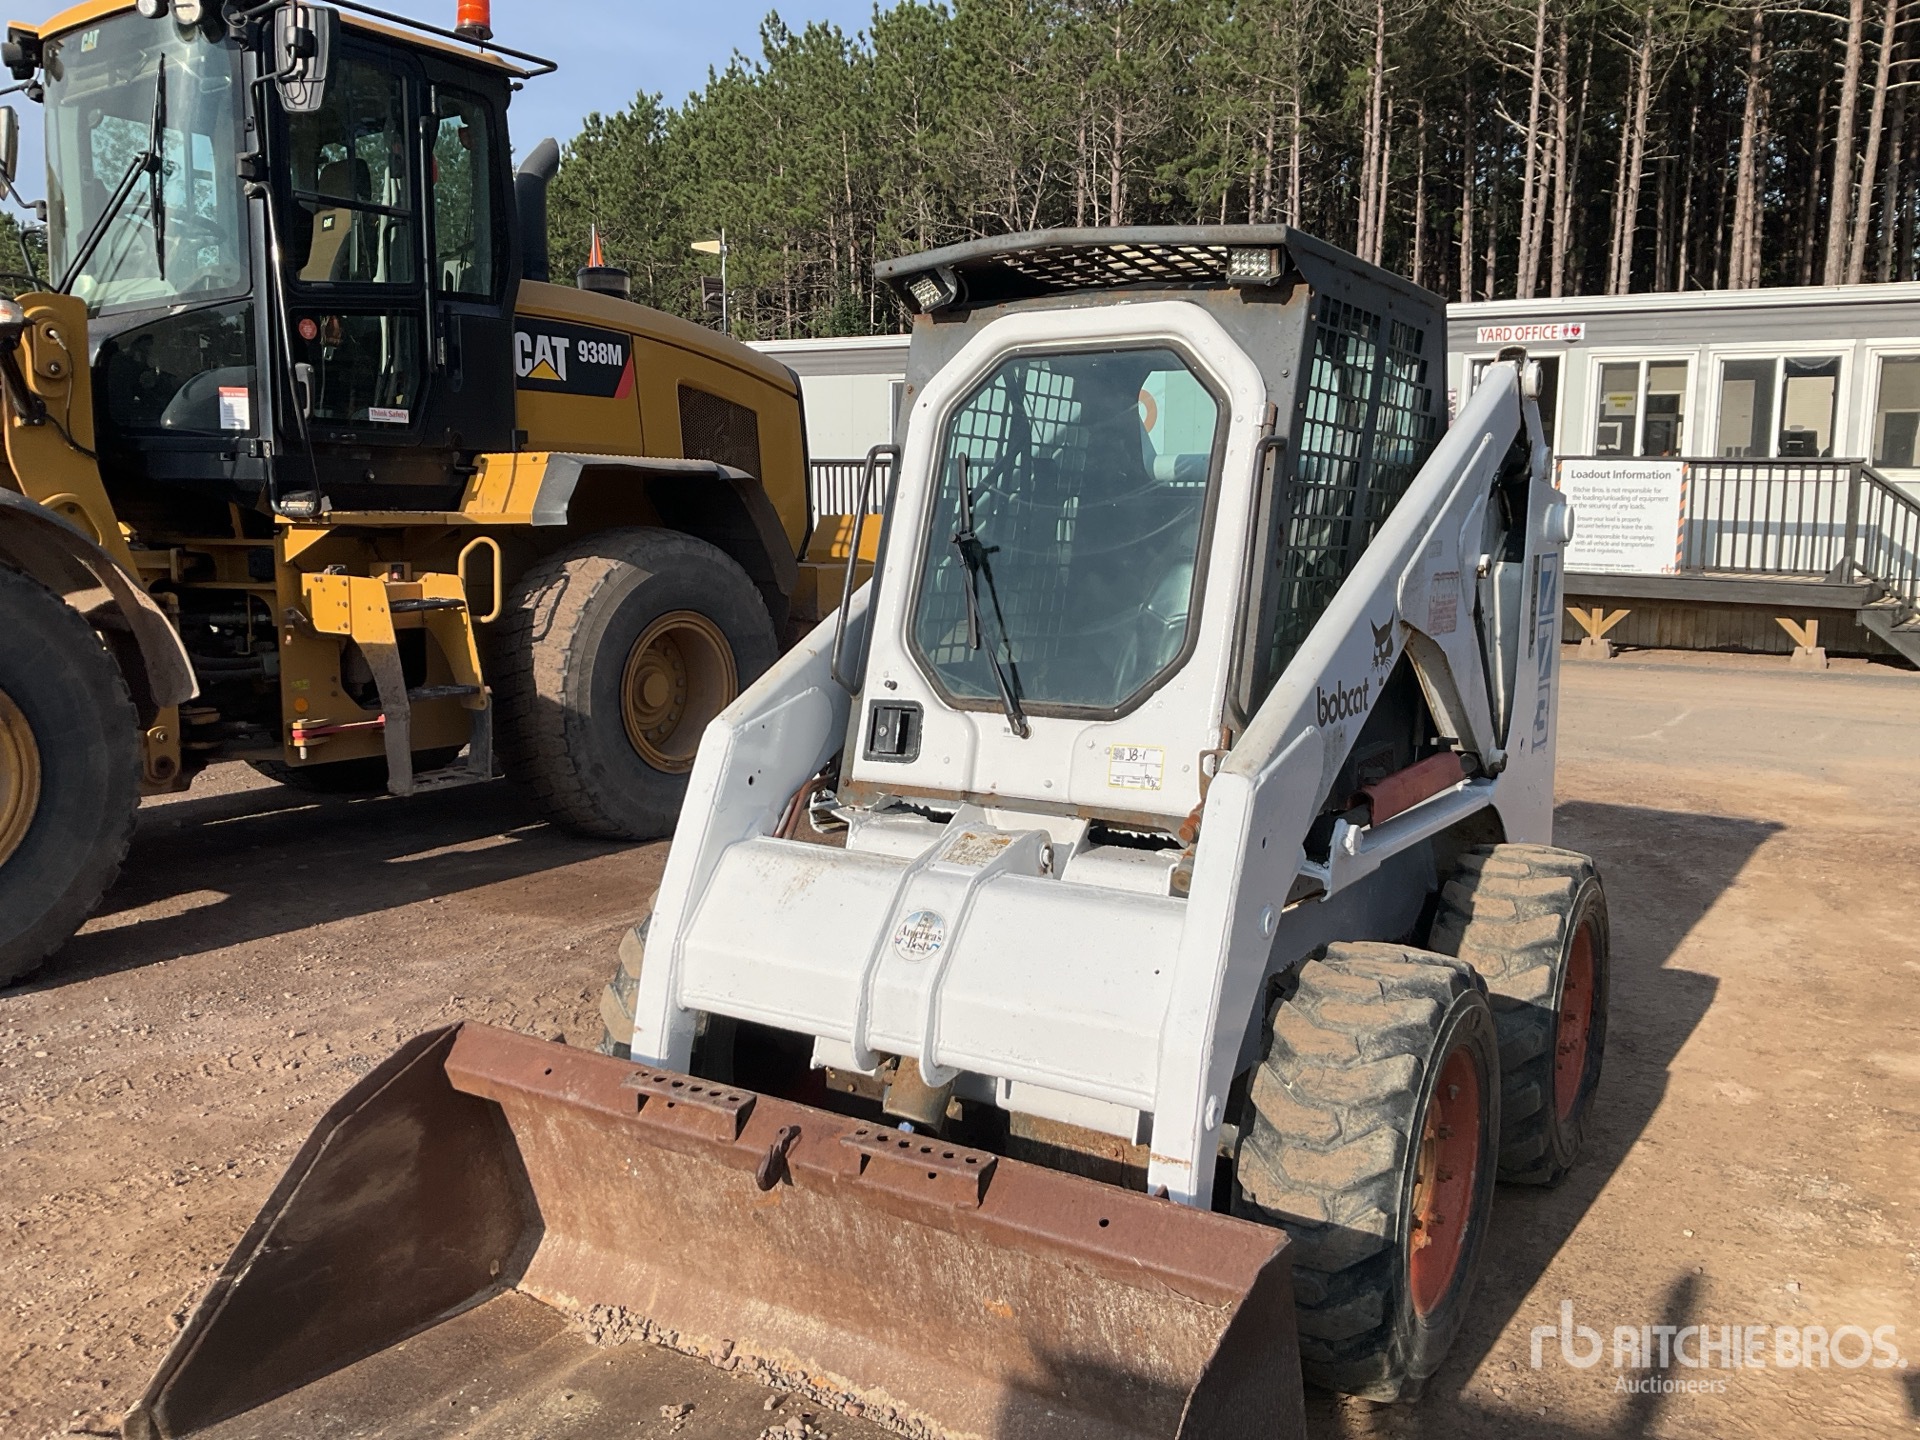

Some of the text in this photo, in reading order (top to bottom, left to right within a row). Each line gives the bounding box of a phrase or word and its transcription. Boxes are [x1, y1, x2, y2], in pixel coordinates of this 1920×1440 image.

[1480, 325, 1558, 342] YARD OFFICE
[514, 331, 622, 381] CAT 938M
[388, 410, 408, 420] Safety
[1571, 470, 1672, 480] Loadout Information
[1317, 677, 1369, 728] bobcat
[900, 924, 942, 942] America's
